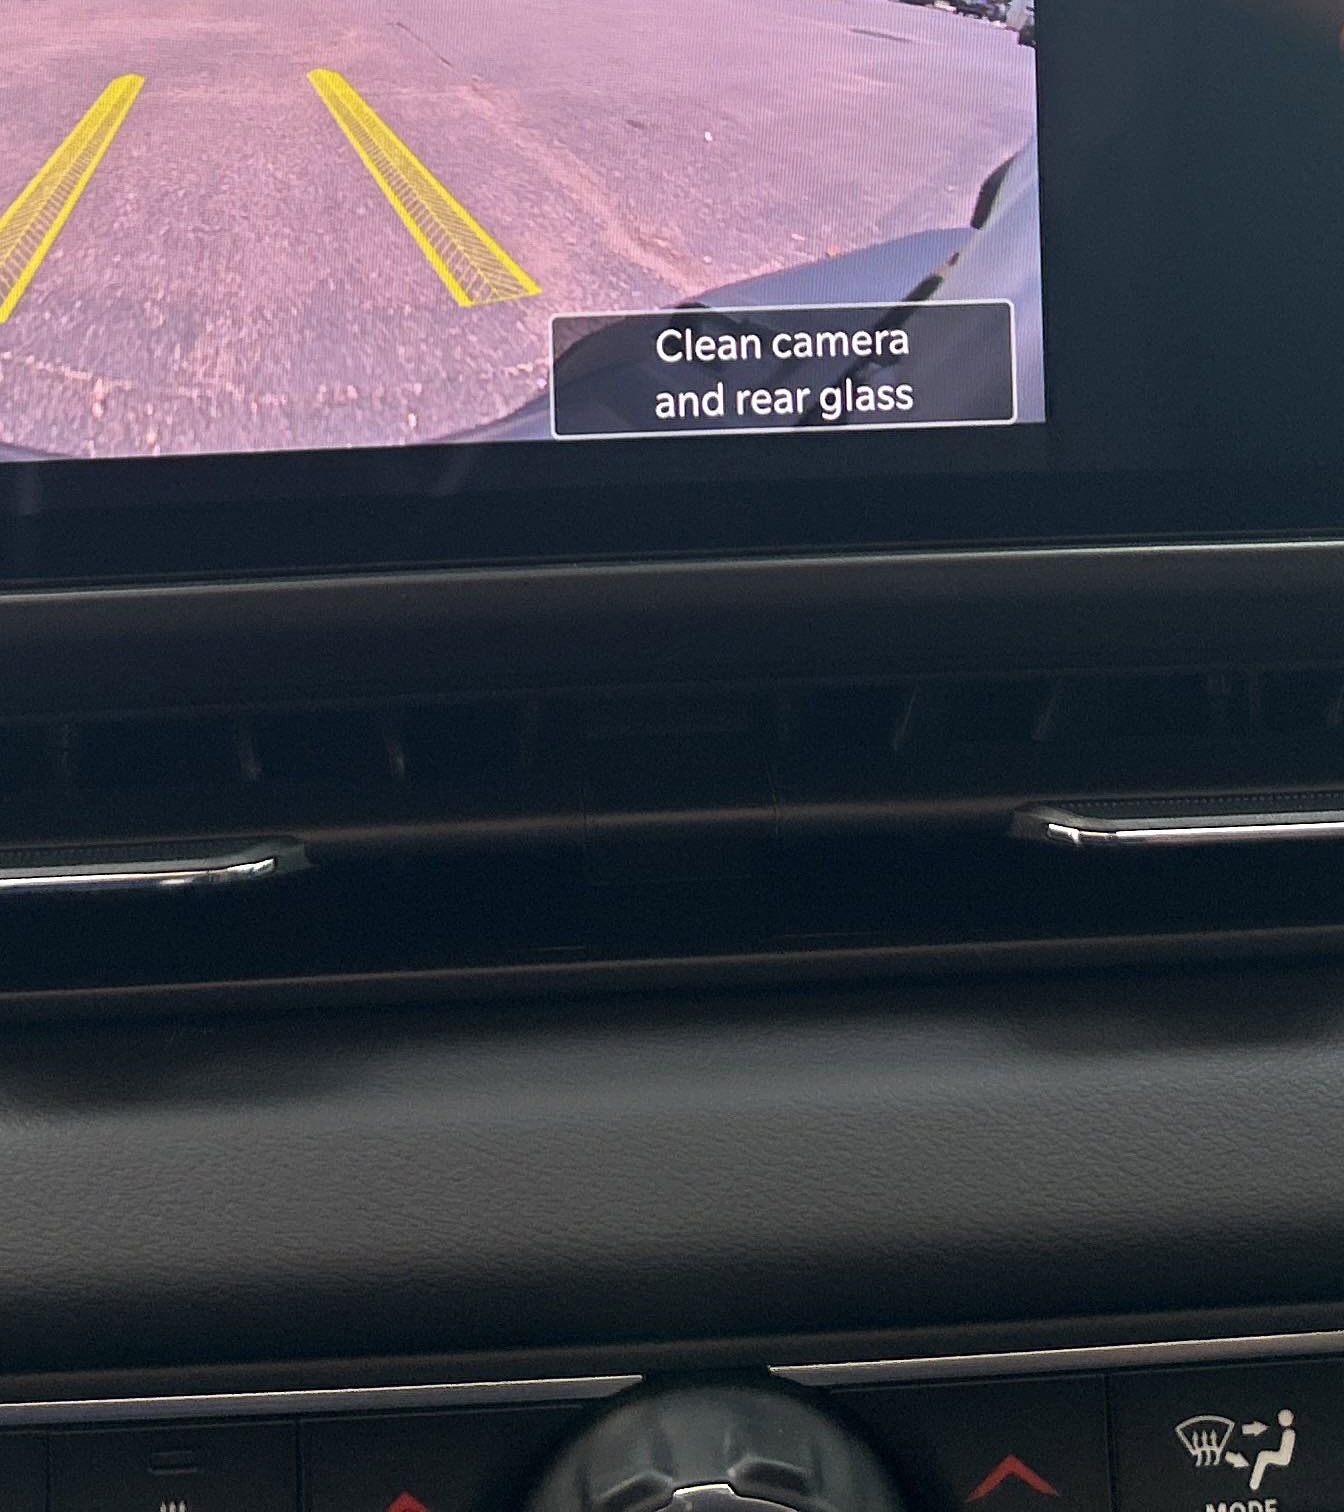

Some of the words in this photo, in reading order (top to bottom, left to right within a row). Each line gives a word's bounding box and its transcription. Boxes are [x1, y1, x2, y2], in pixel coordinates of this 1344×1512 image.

[656, 328, 762, 363] Clean
[771, 328, 910, 360] camera
[655, 381, 725, 419] and
[736, 384, 810, 416] rear
[818, 377, 915, 420] glass
